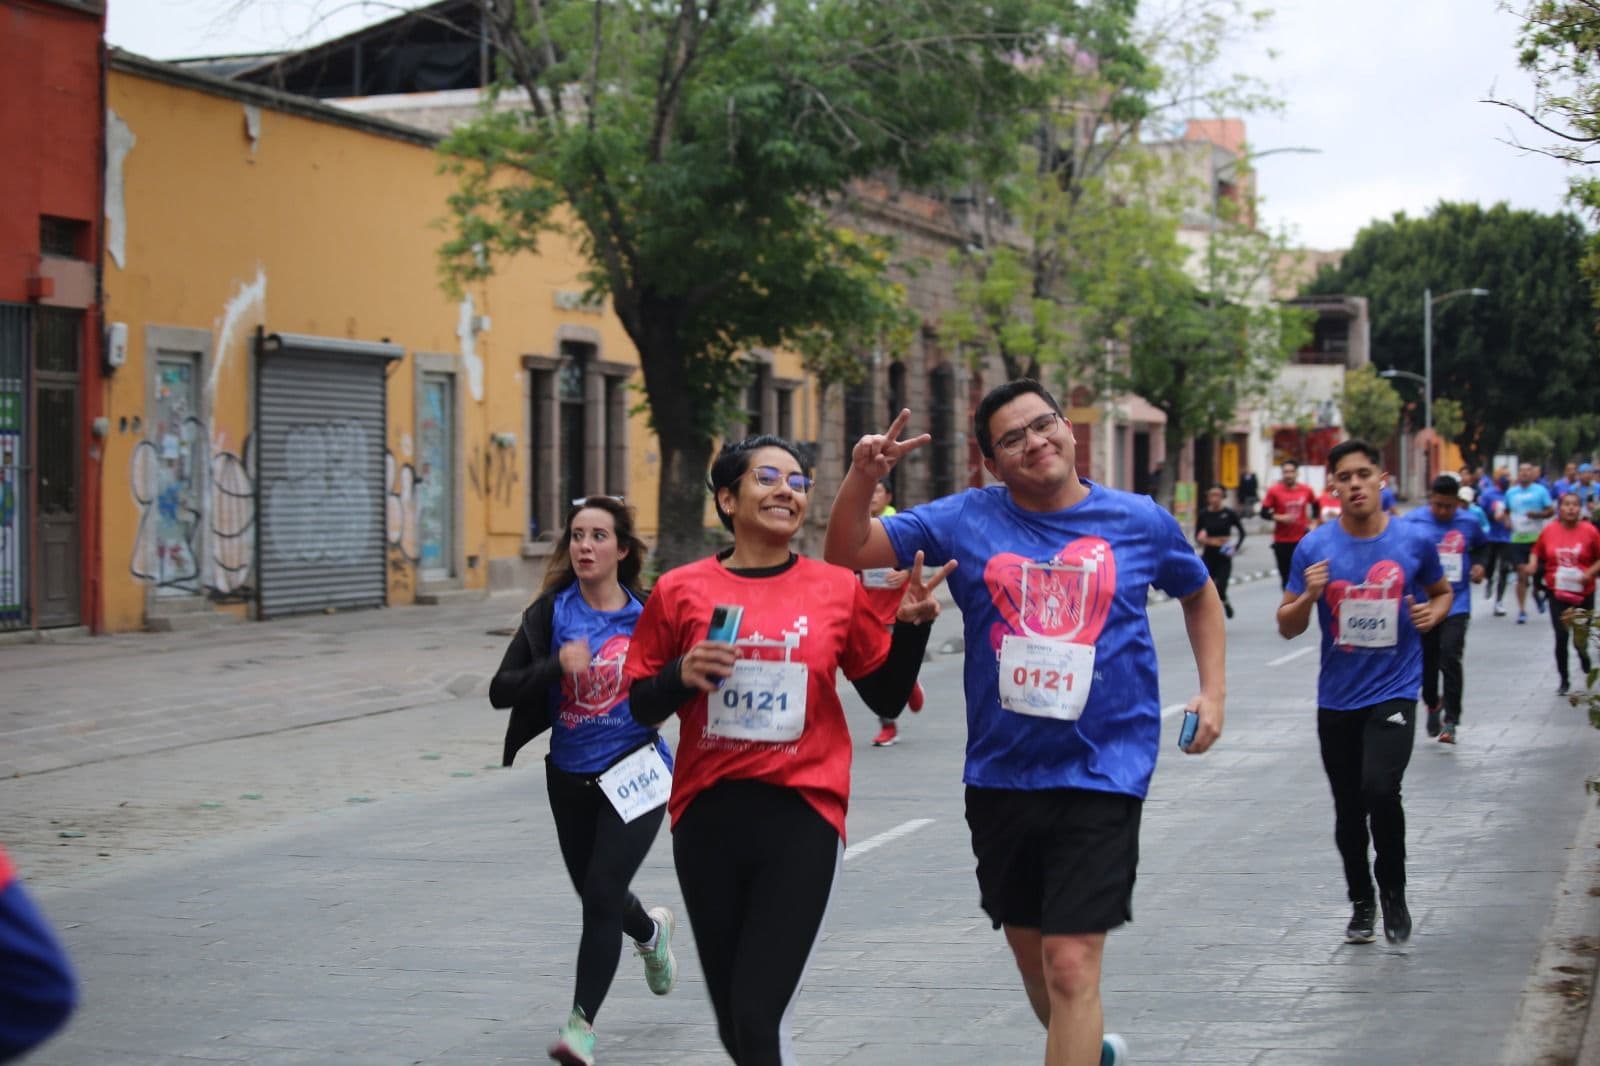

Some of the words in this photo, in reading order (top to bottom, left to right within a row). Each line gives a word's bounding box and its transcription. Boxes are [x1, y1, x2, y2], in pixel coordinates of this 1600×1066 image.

[1347, 616, 1386, 631] 0691
[1013, 666, 1074, 692] 0121
[723, 688, 788, 712] 0121
[617, 767, 660, 799] 0154
